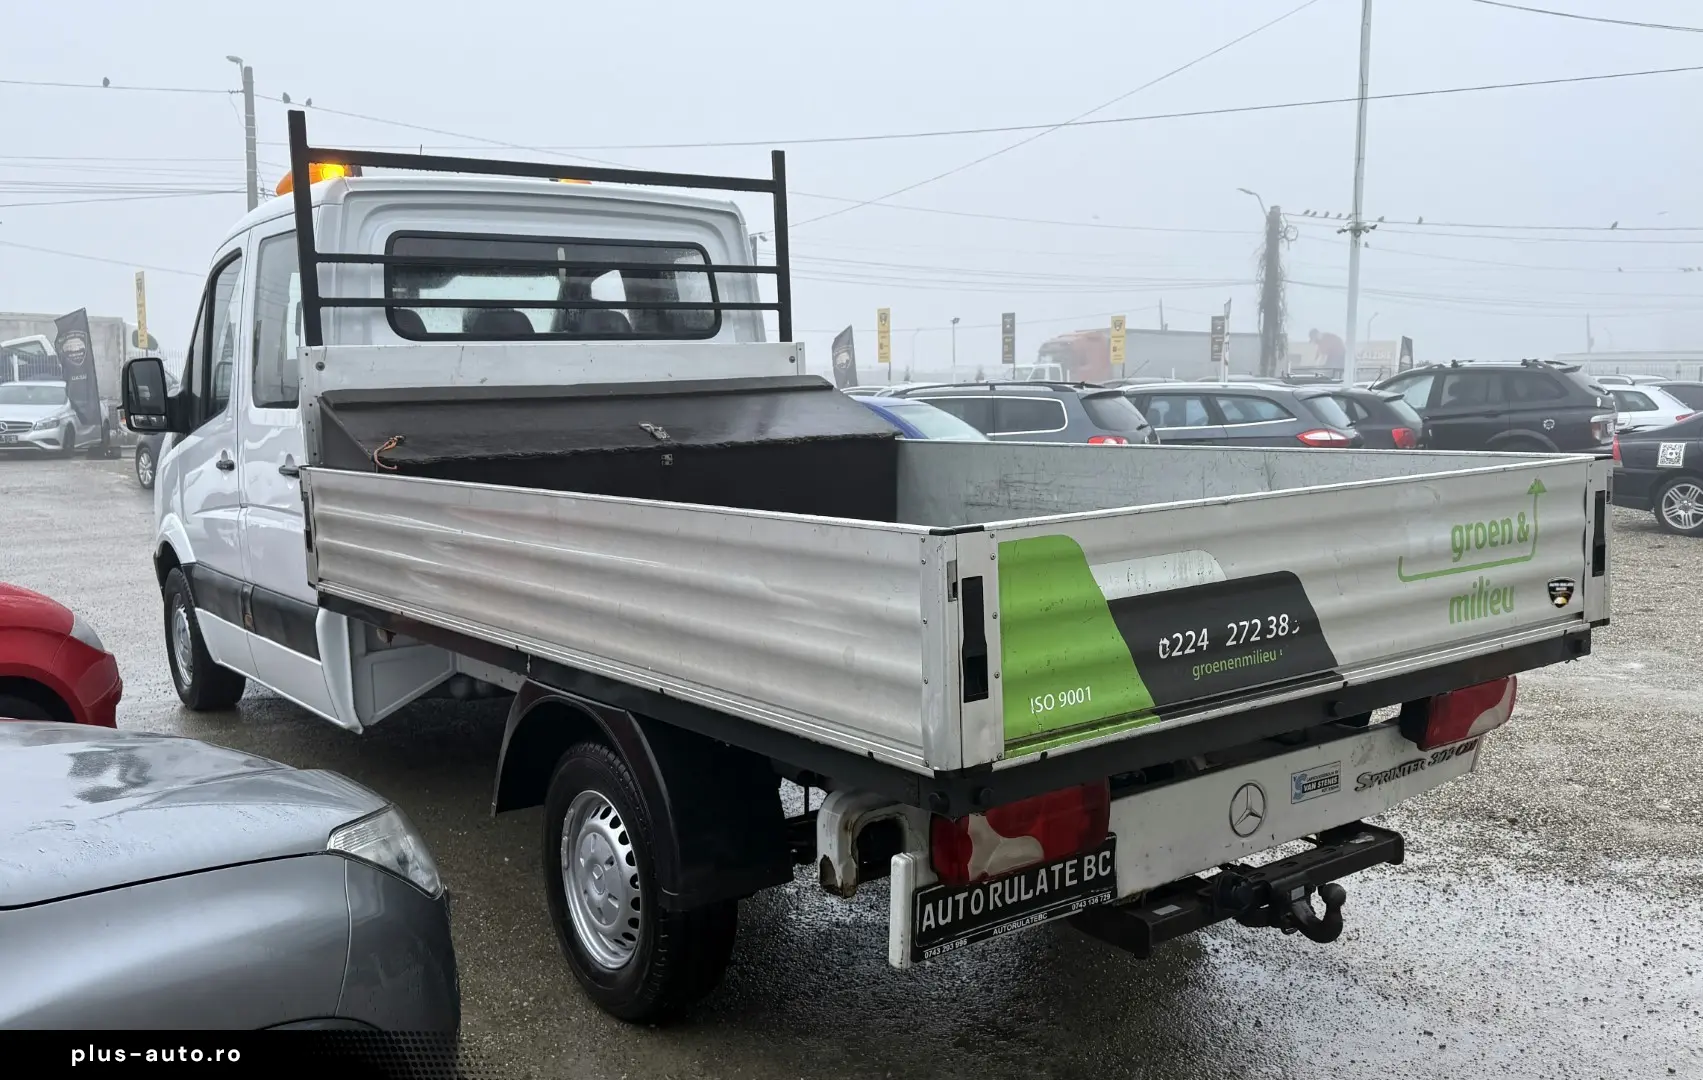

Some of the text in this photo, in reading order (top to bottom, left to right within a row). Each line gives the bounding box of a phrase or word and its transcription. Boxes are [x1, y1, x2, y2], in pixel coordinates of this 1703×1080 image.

[1450, 517, 1513, 562] groen
[1449, 576, 1515, 625] milieu
[1225, 618, 1261, 647] 272
[1030, 686, 1092, 714] ISO 9001
[1303, 781, 1317, 792] VAN
[1083, 850, 1111, 882] BC
